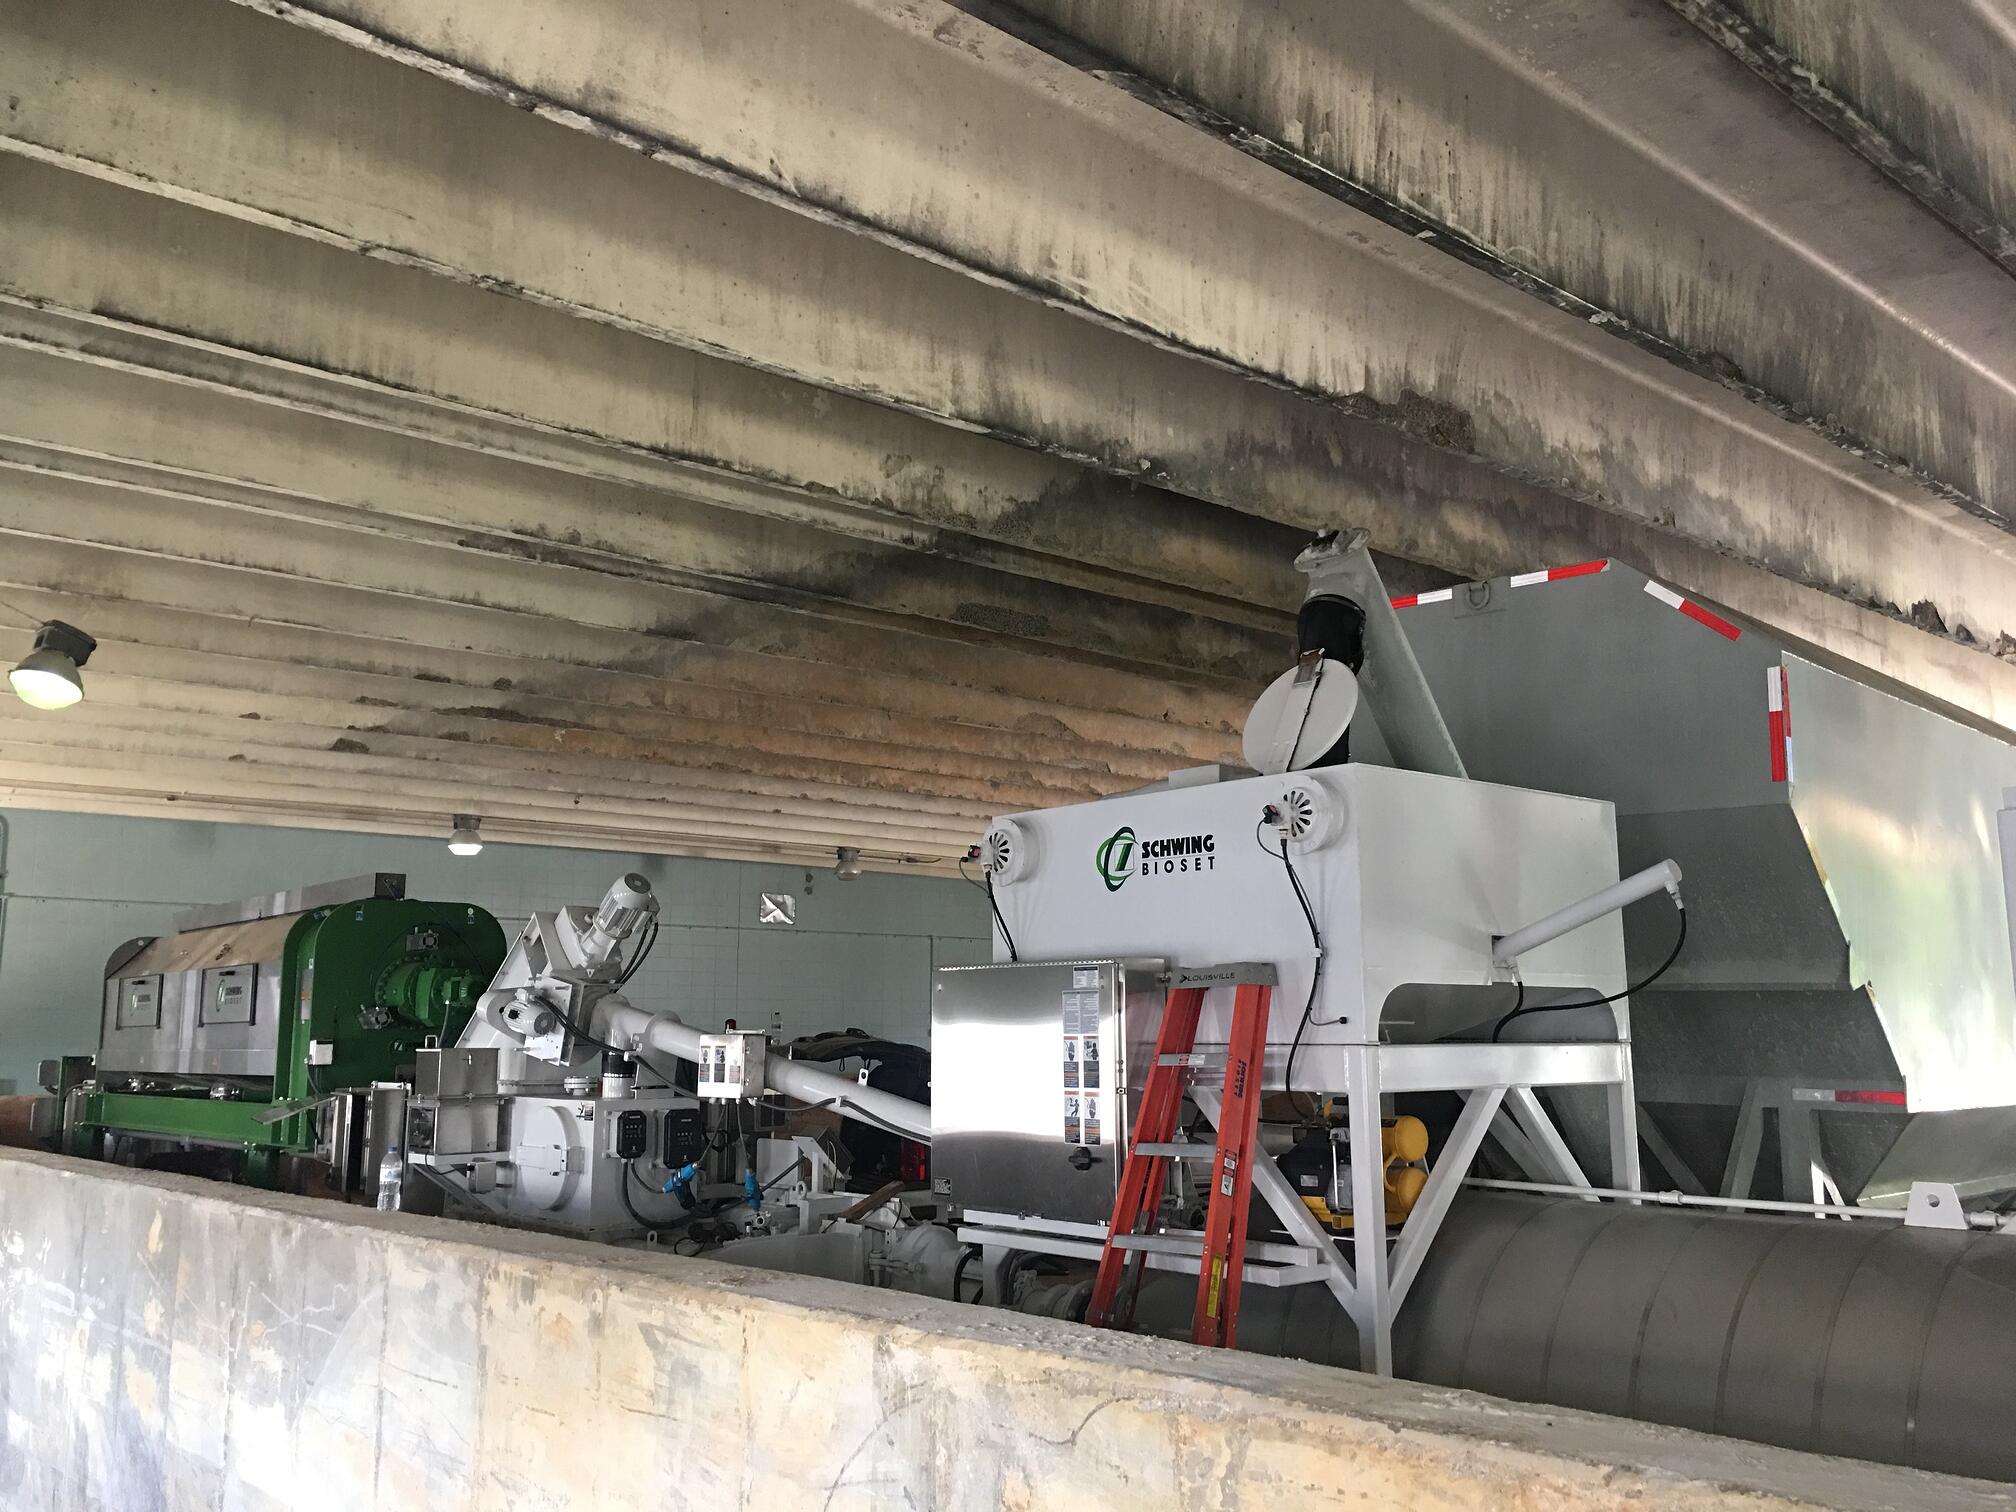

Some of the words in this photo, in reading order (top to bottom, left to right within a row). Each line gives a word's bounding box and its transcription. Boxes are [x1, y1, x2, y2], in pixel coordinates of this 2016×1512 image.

[1142, 835, 1215, 859] SCHWING
[1142, 856, 1215, 876] BIOSET
[1187, 972, 1236, 982] LOUISVILLE
